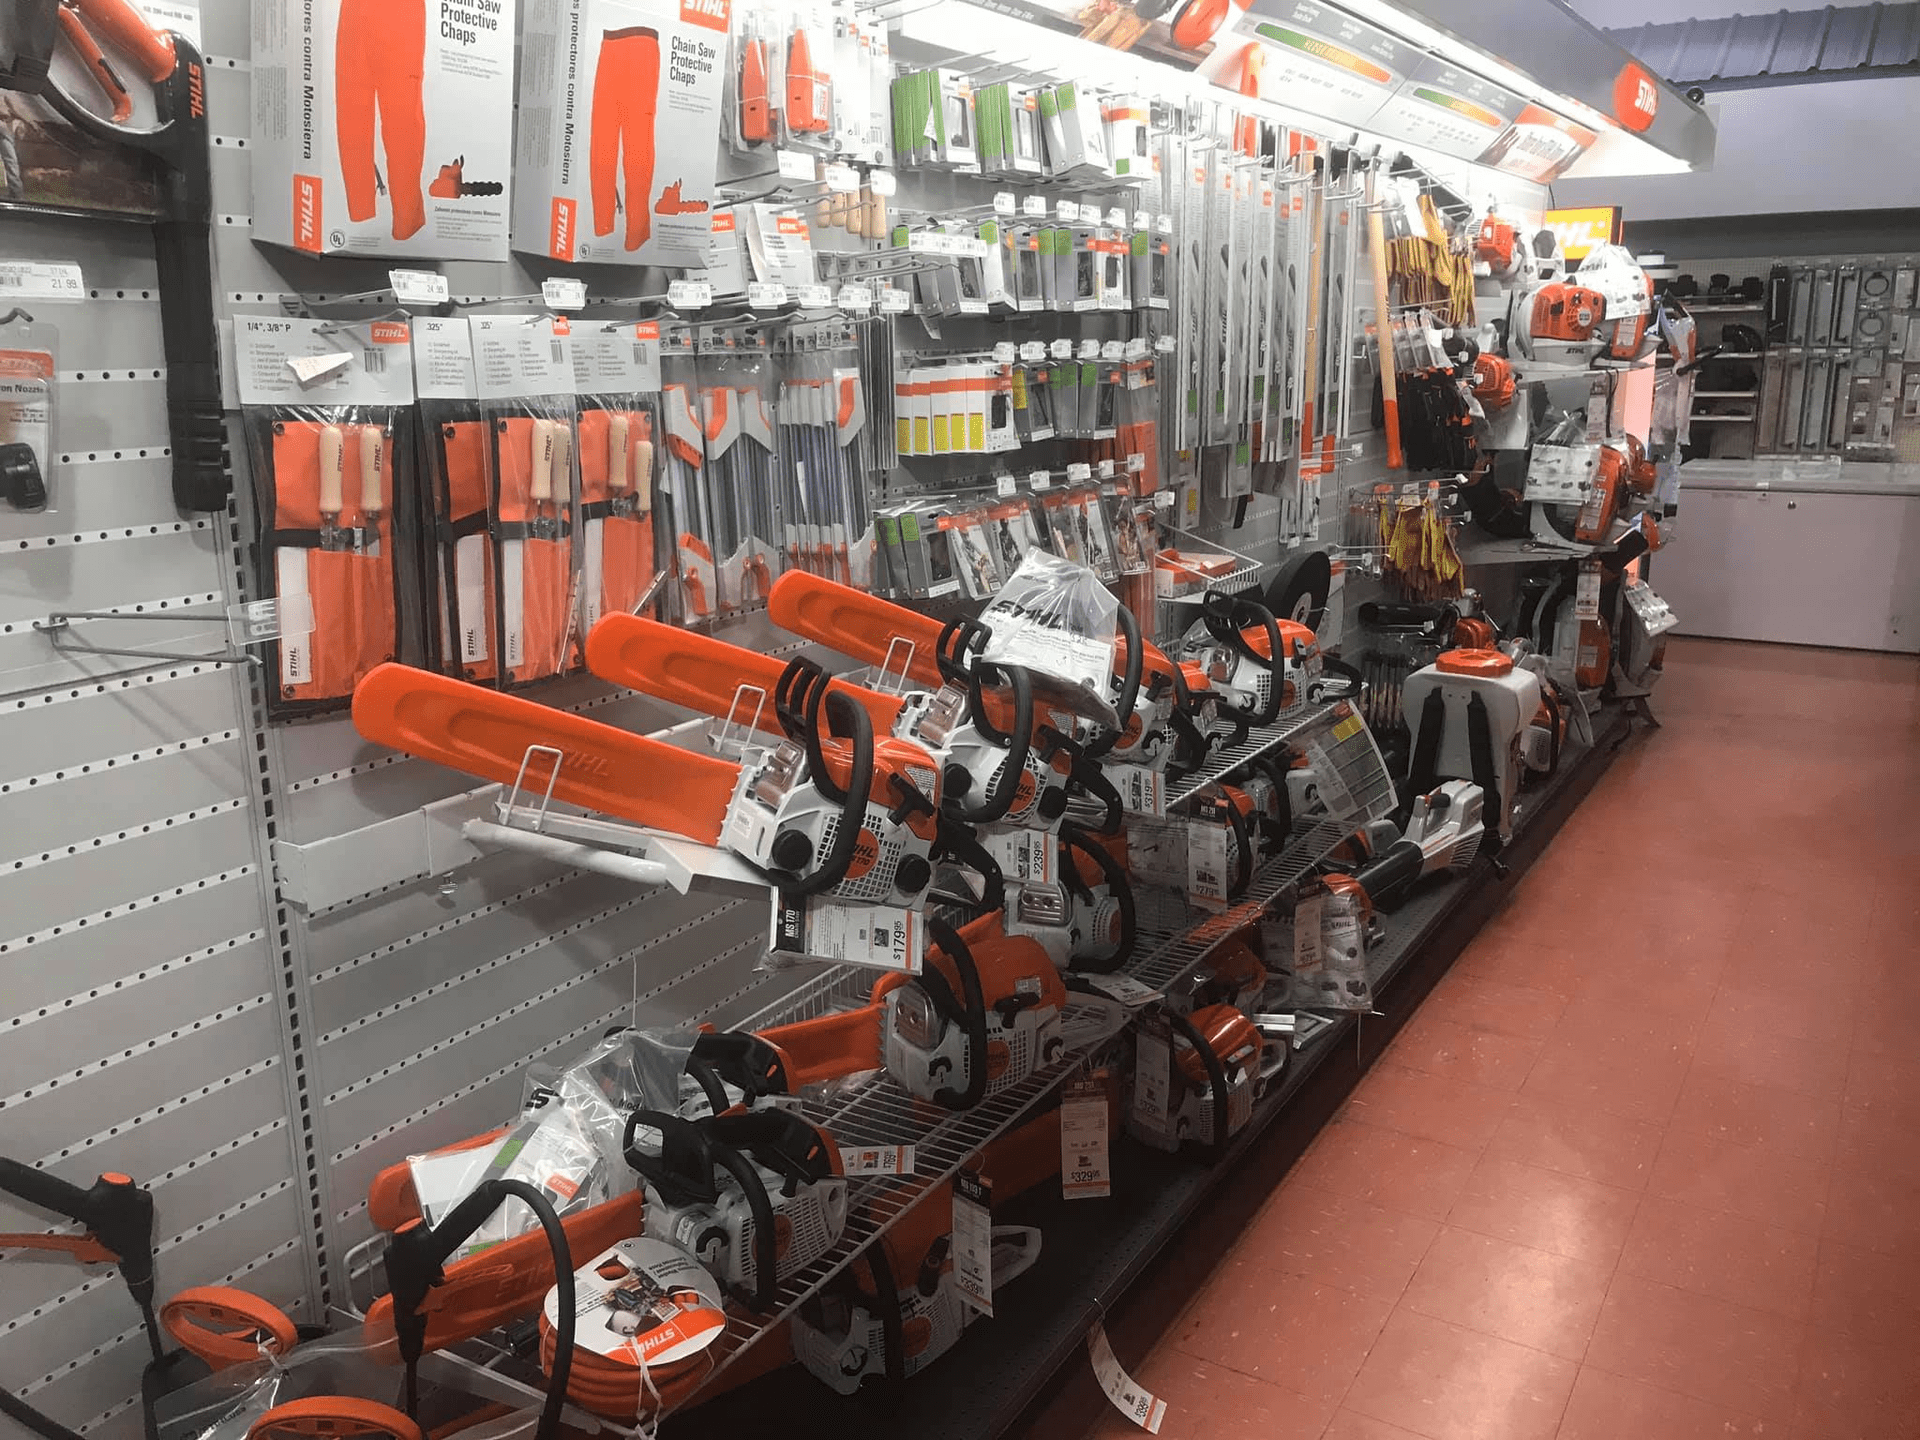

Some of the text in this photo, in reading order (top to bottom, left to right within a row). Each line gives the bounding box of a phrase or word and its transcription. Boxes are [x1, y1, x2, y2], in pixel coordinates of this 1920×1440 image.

[440, 3, 498, 31] Protective
[684, 0, 726, 19] STIHL
[440, 21, 477, 46] Chaps
[567, 12, 579, 80] protectores
[671, 36, 716, 60] Chain Saw
[302, 37, 313, 81] contra
[670, 51, 713, 74] Protective
[188, 61, 204, 119] STIHL
[669, 66, 696, 87] Chaps
[565, 83, 576, 120] contra
[1634, 78, 1657, 116] STIHL
[303, 86, 314, 160] Motosierra
[561, 122, 575, 186] Motosierra
[299, 181, 314, 243] STIHL
[554, 202, 569, 255] STIHL
[285, 323, 291, 332] P
[374, 328, 405, 338] STIHL
[374, 443, 382, 473] STIHL
[544, 434, 553, 463] STIHL
[467, 628, 475, 656] STIHL
[290, 646, 298, 677] STIHL
[785, 909, 796, 938] MS 170
